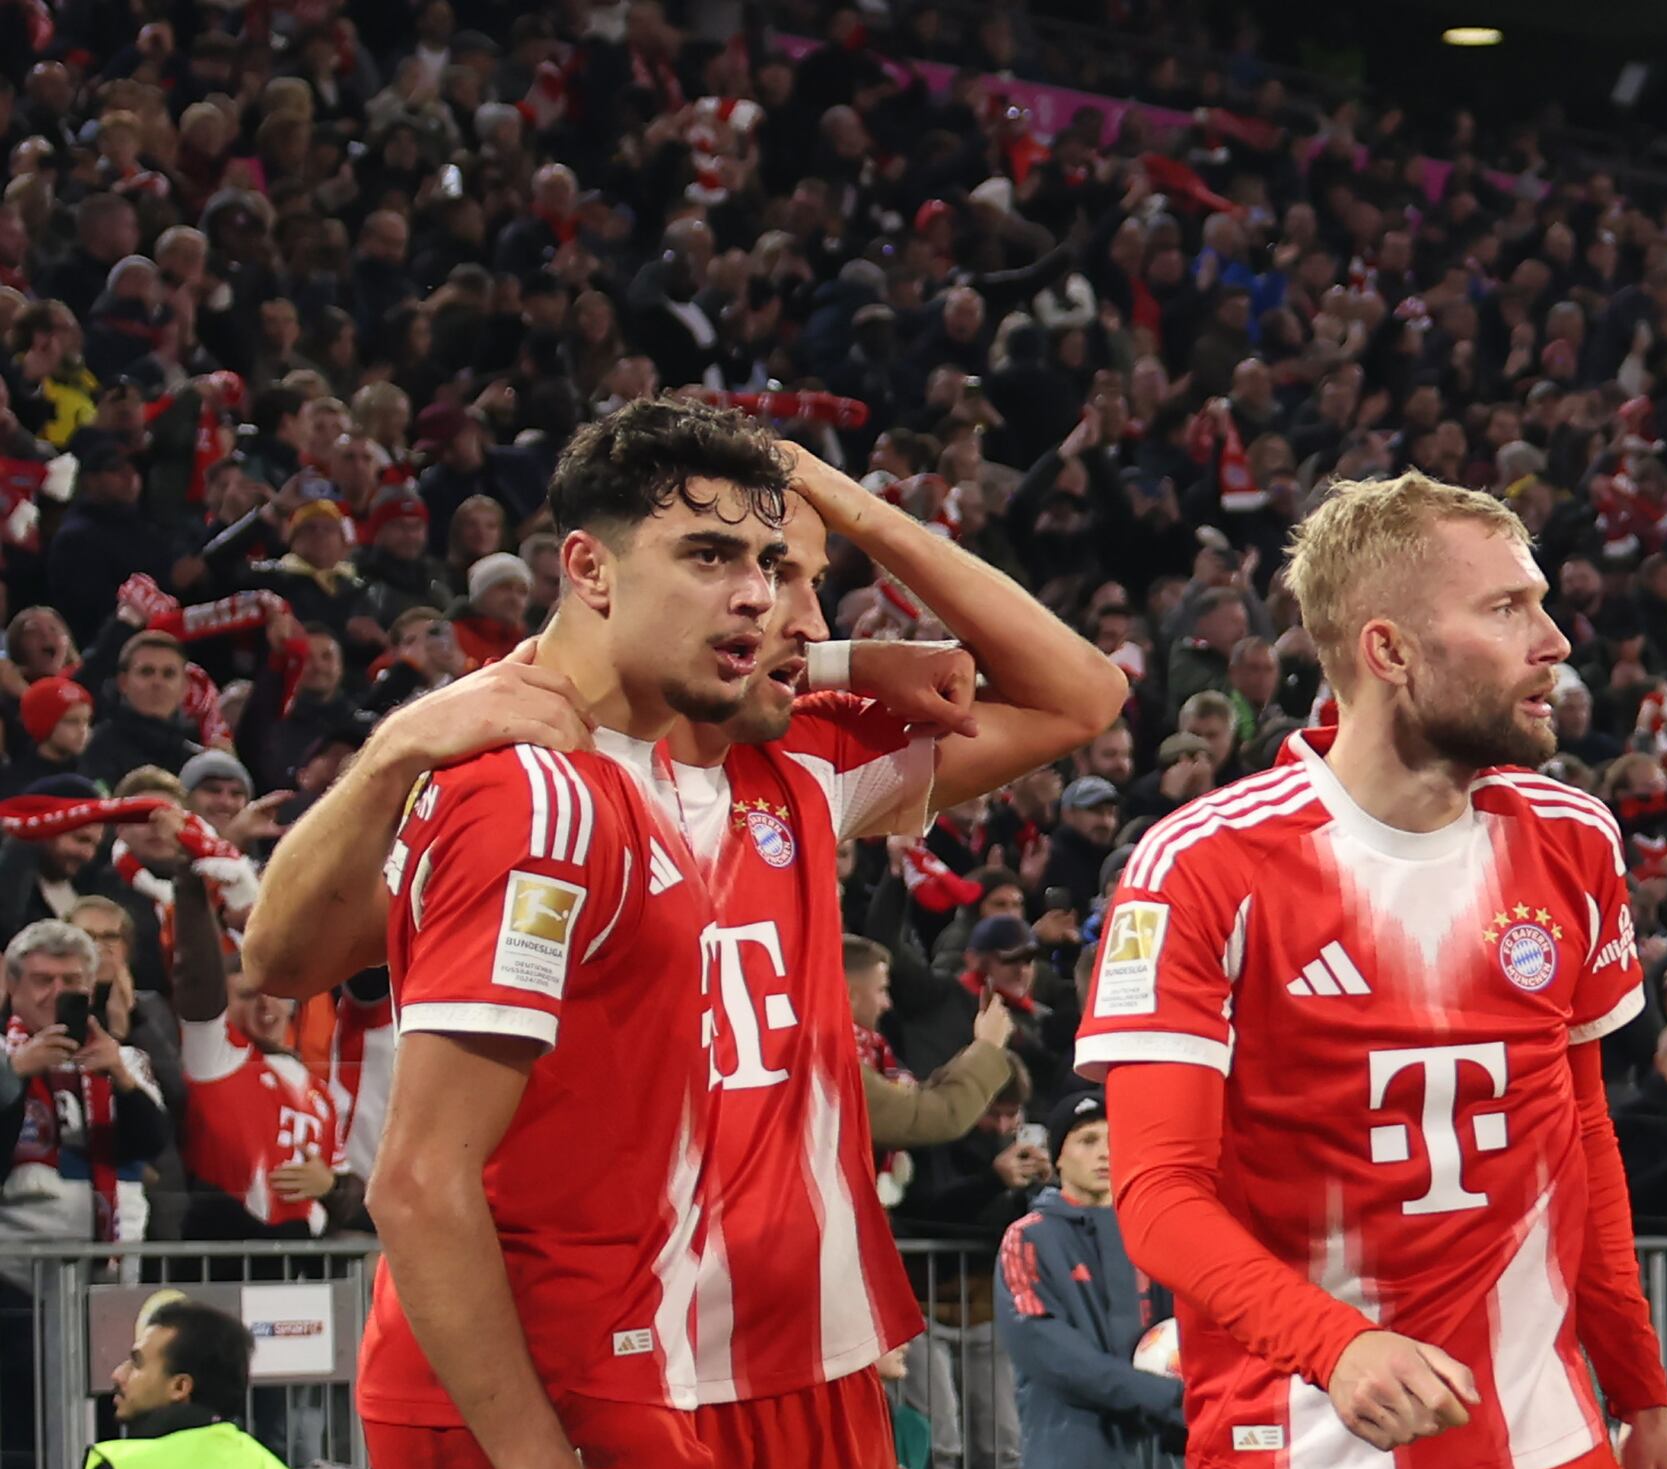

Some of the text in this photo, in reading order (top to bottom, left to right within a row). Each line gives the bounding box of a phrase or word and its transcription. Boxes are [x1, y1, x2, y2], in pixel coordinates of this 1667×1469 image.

[505, 936, 563, 959] BUNDESLIGA
[1511, 927, 1551, 952] BAYERN
[1368, 1041, 1509, 1216] T
